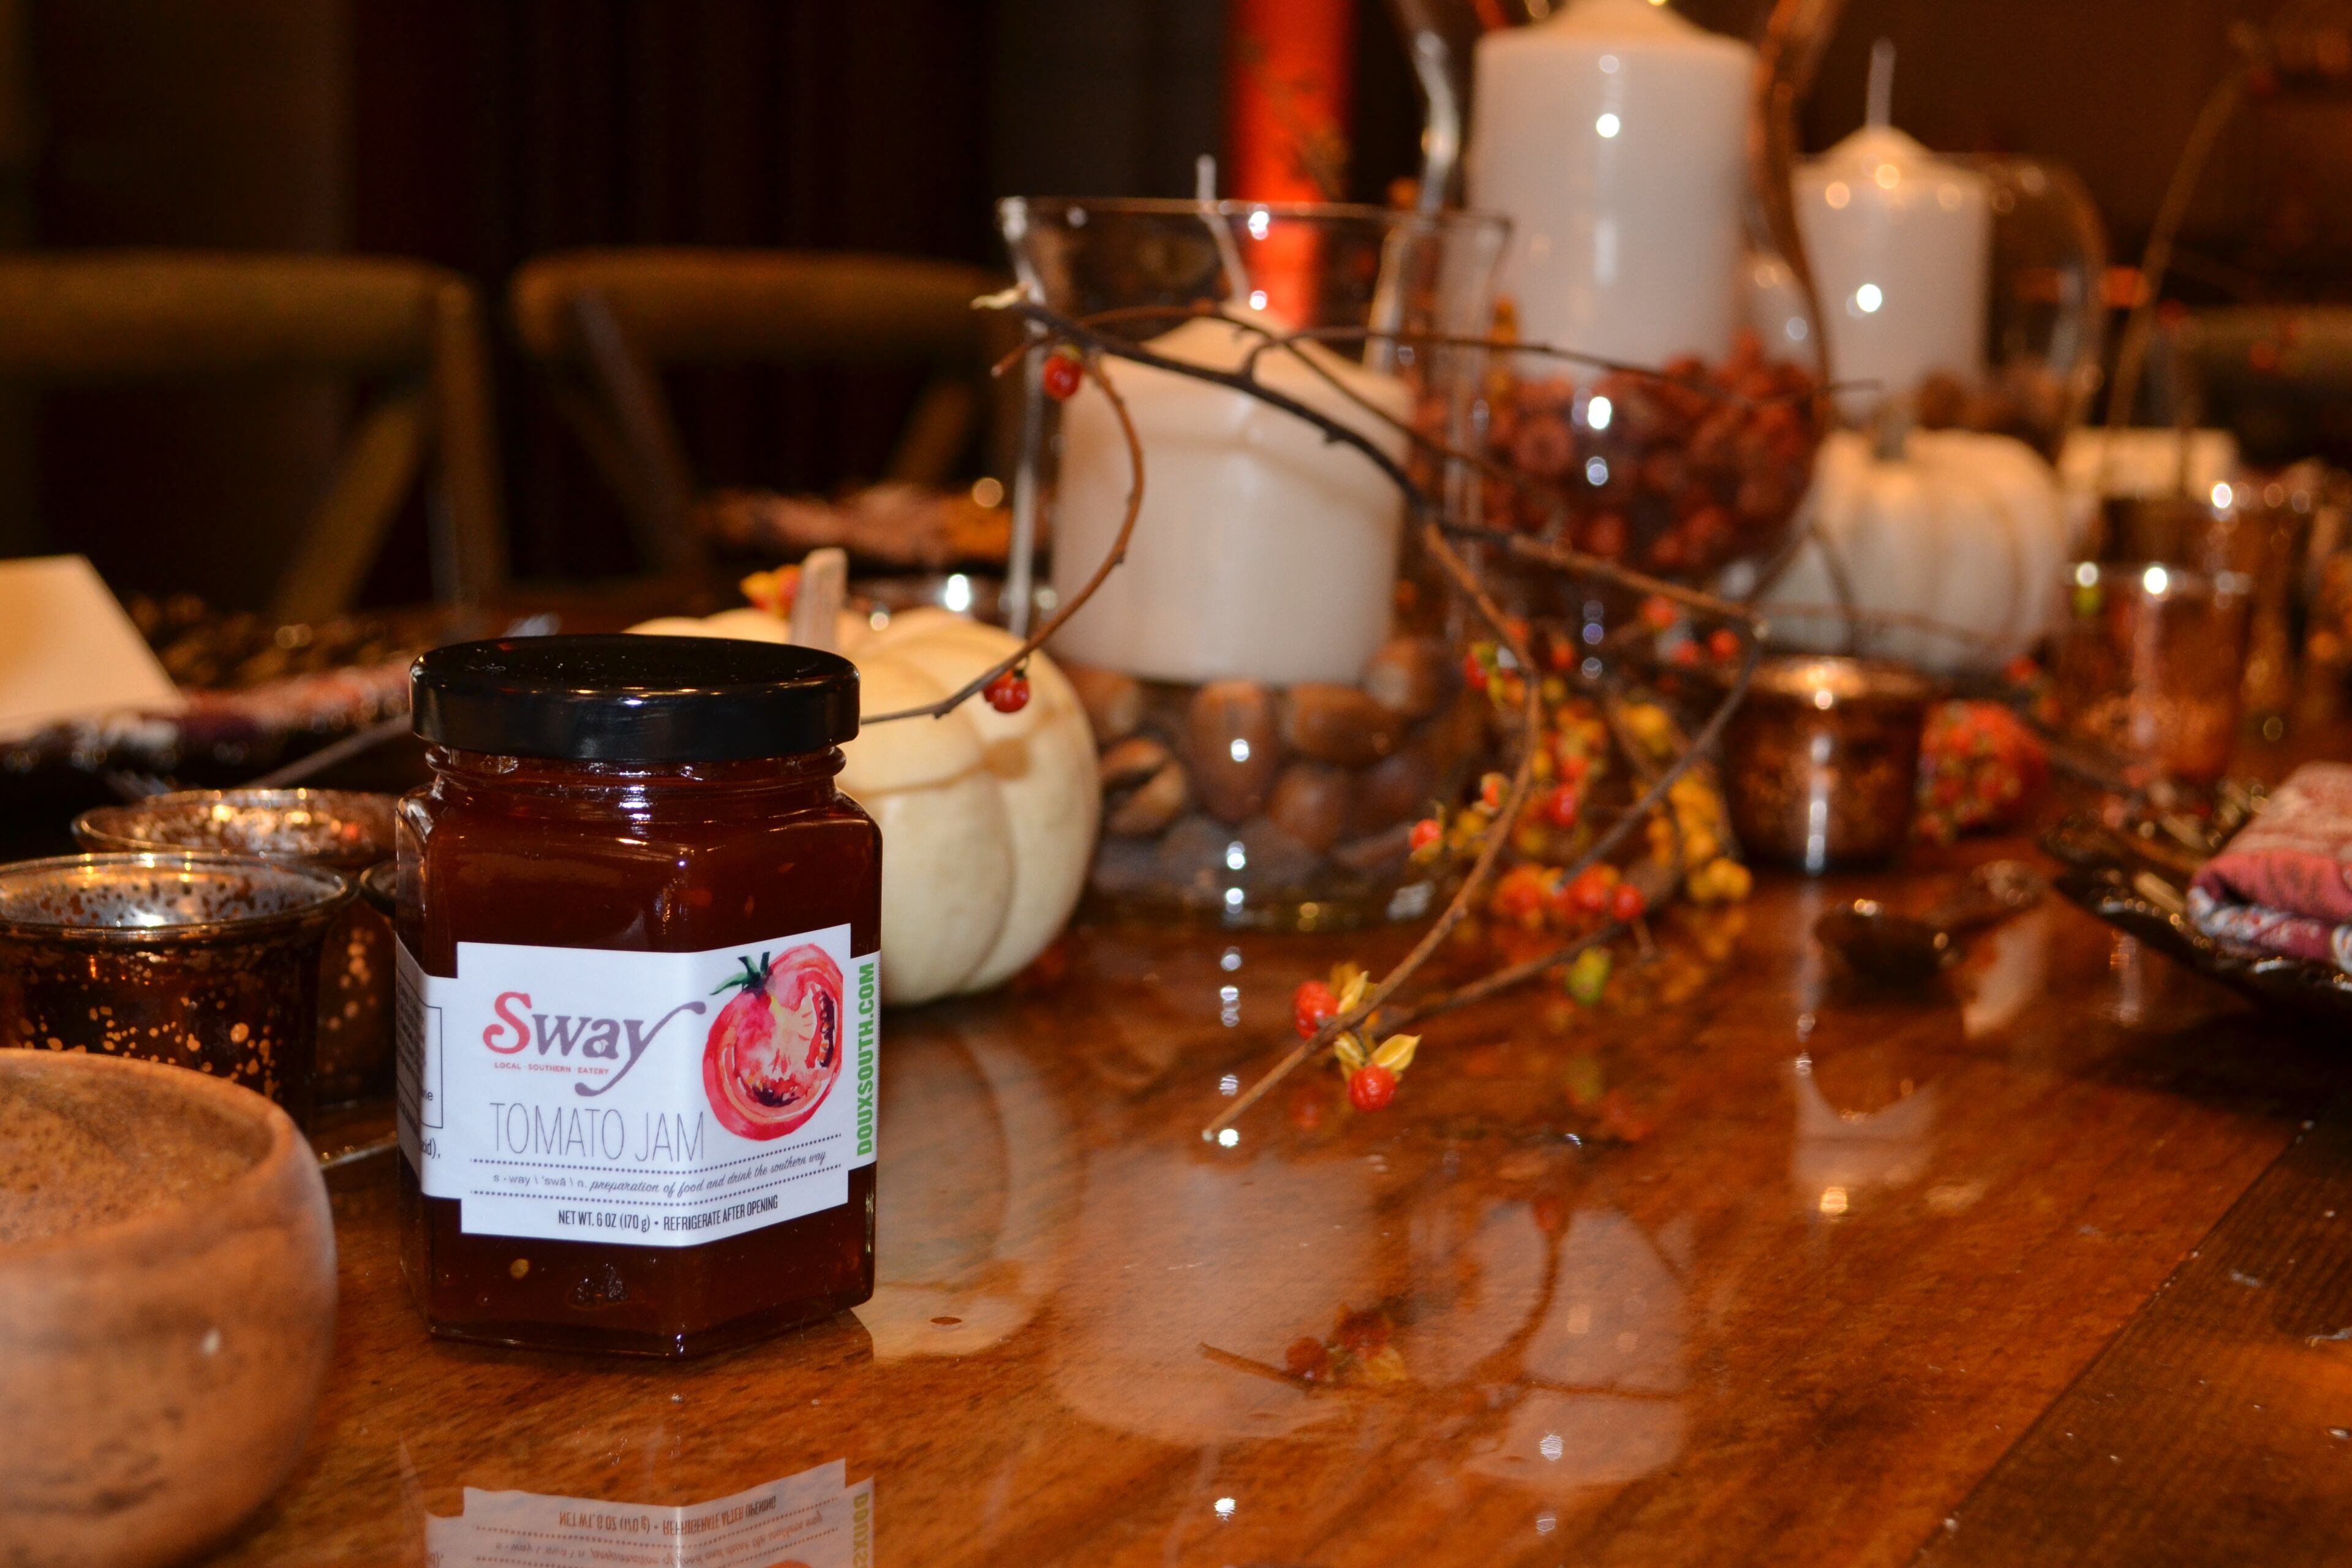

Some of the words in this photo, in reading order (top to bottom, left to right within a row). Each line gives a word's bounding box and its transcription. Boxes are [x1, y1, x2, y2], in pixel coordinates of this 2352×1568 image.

[483, 992, 706, 1097] Sway
[528, 1064, 571, 1073] SOUTHERN
[857, 962, 875, 1156] DOUXSOUTH.COM
[489, 1102, 624, 1160] TOMATO
[635, 1110, 704, 1162] JAM
[508, 1175, 531, 1186] way
[589, 1180, 660, 1193] preparation
[663, 1182, 676, 1198] of
[677, 1178, 704, 1199] food
[706, 1175, 726, 1190] and
[727, 1171, 752, 1185] drink
[754, 1165, 768, 1178] the
[770, 1154, 807, 1174] southern
[809, 1150, 827, 1165] way
[558, 1210, 576, 1225] NET
[578, 1212, 594, 1226] WT.
[597, 1212, 603, 1227] 6
[605, 1213, 617, 1227] OZ
[620, 1214, 639, 1229] (170
[641, 1215, 650, 1232] g)
[663, 1209, 722, 1231] REFRIGERATE
[722, 1203, 745, 1223] AFTER
[747, 1194, 778, 1216] OPENING
